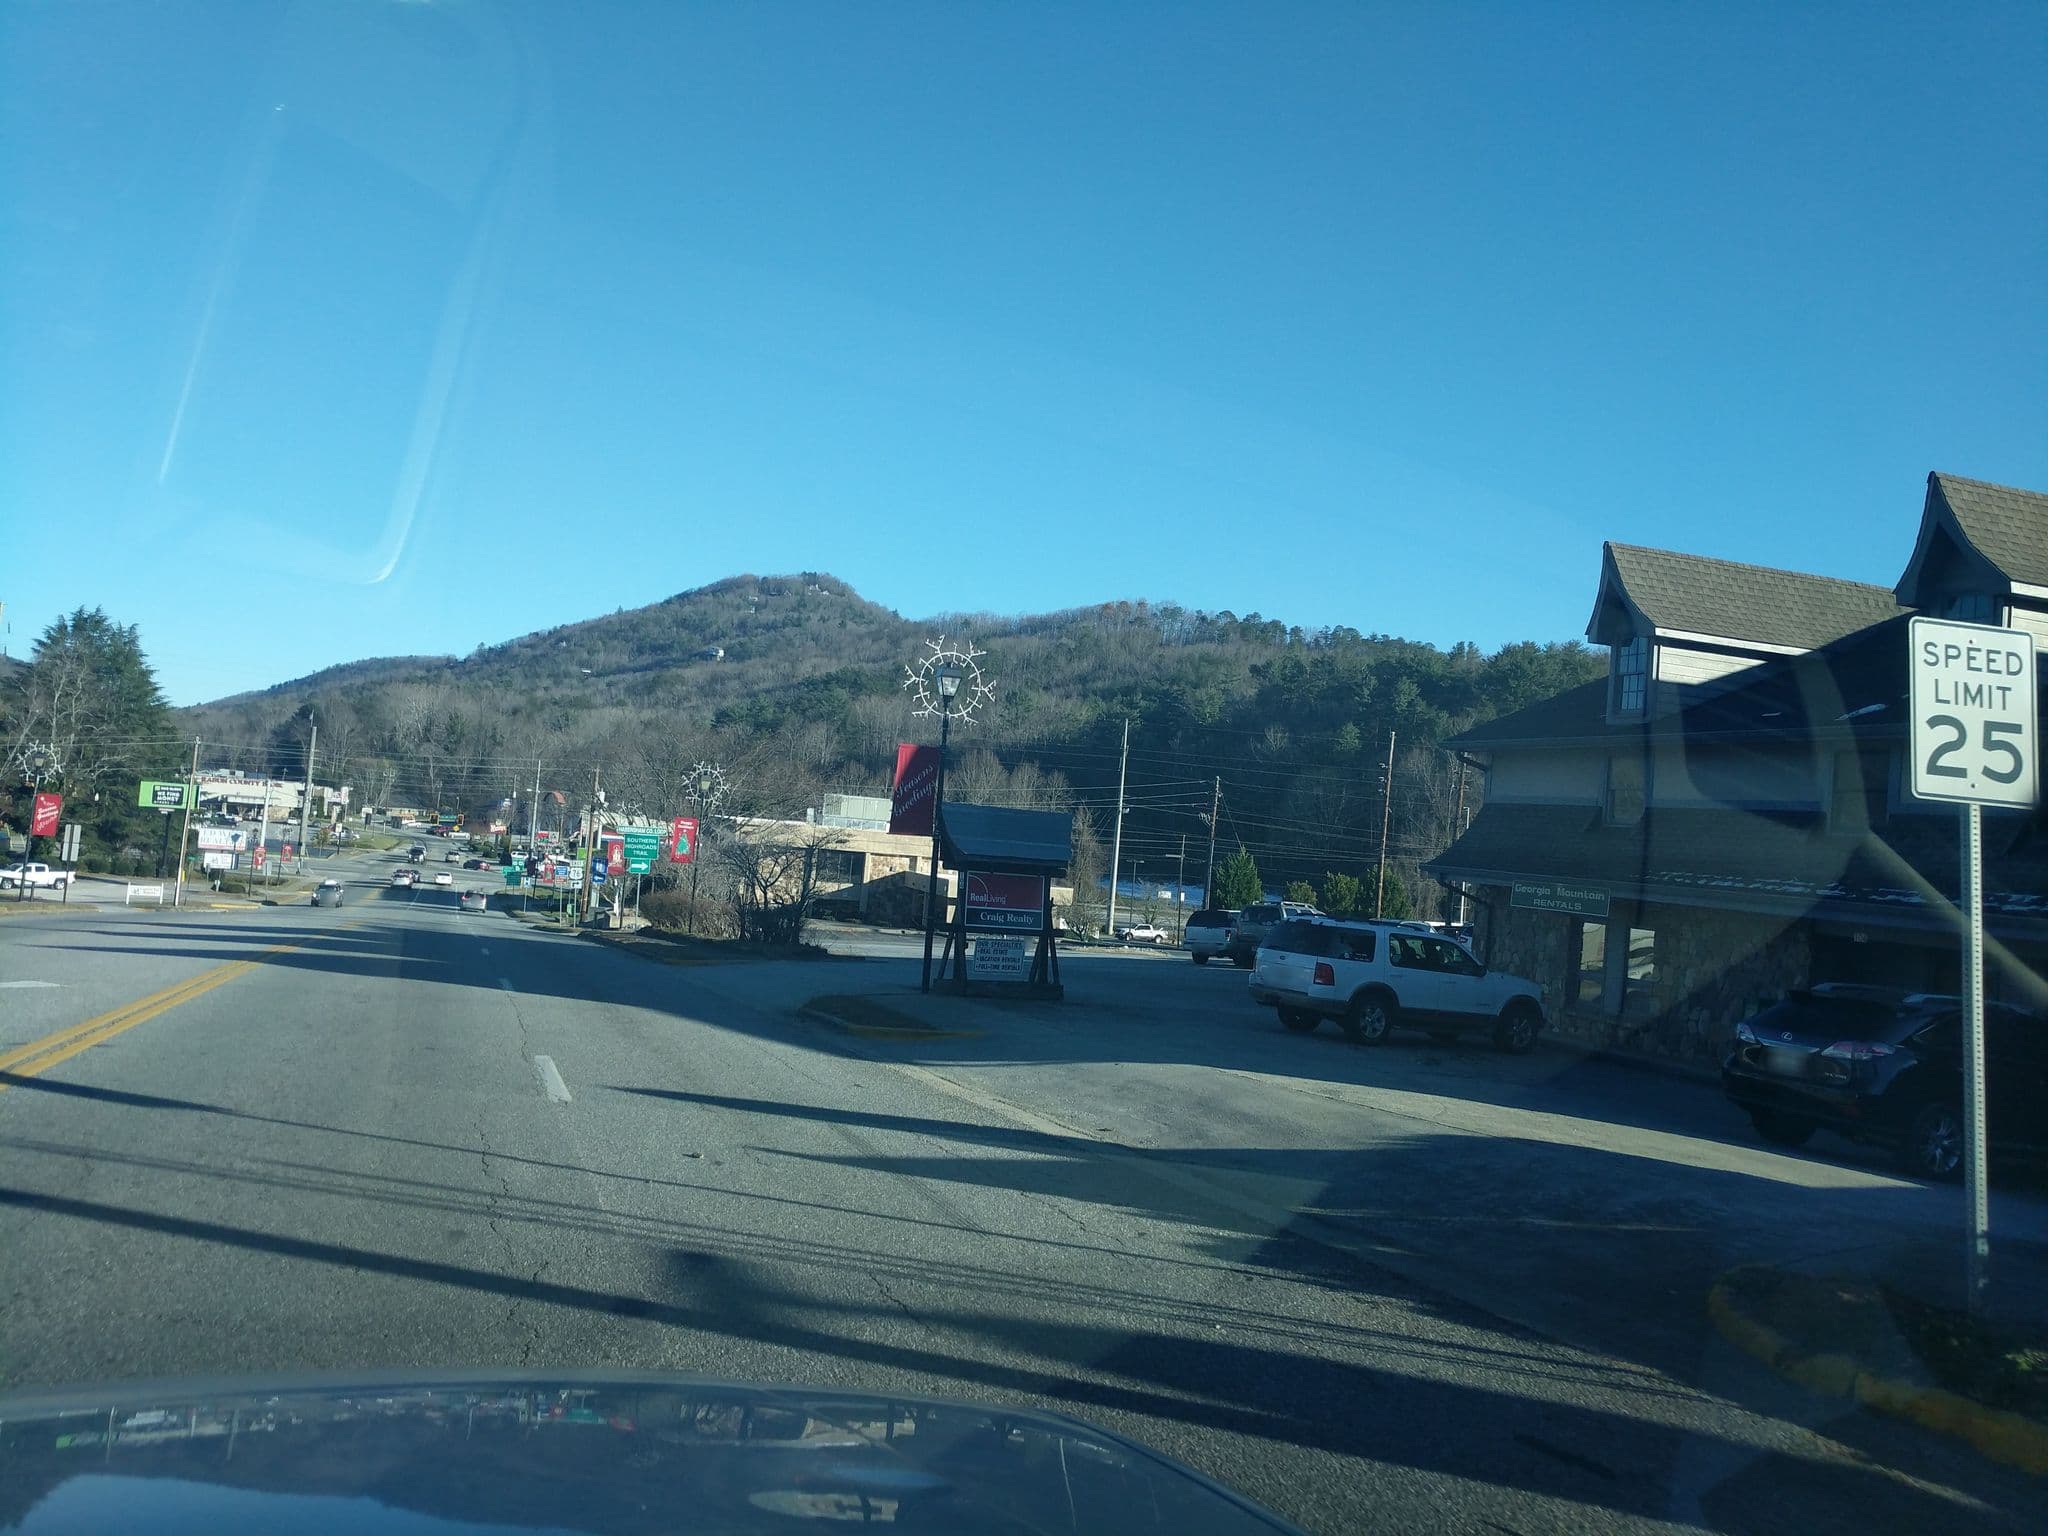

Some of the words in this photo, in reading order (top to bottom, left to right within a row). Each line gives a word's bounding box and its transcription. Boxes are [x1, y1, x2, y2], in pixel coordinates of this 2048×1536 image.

[1923, 641, 2023, 676] SPEED
[1934, 678, 2012, 711] LIMIT
[1925, 714, 2023, 784] 25
[1514, 884, 1551, 896] Georgia
[1556, 888, 1605, 901] Mountain
[1533, 899, 1582, 910] RENTALS
[980, 912, 1004, 923] Craig
[1007, 913, 1034, 925] Realty
